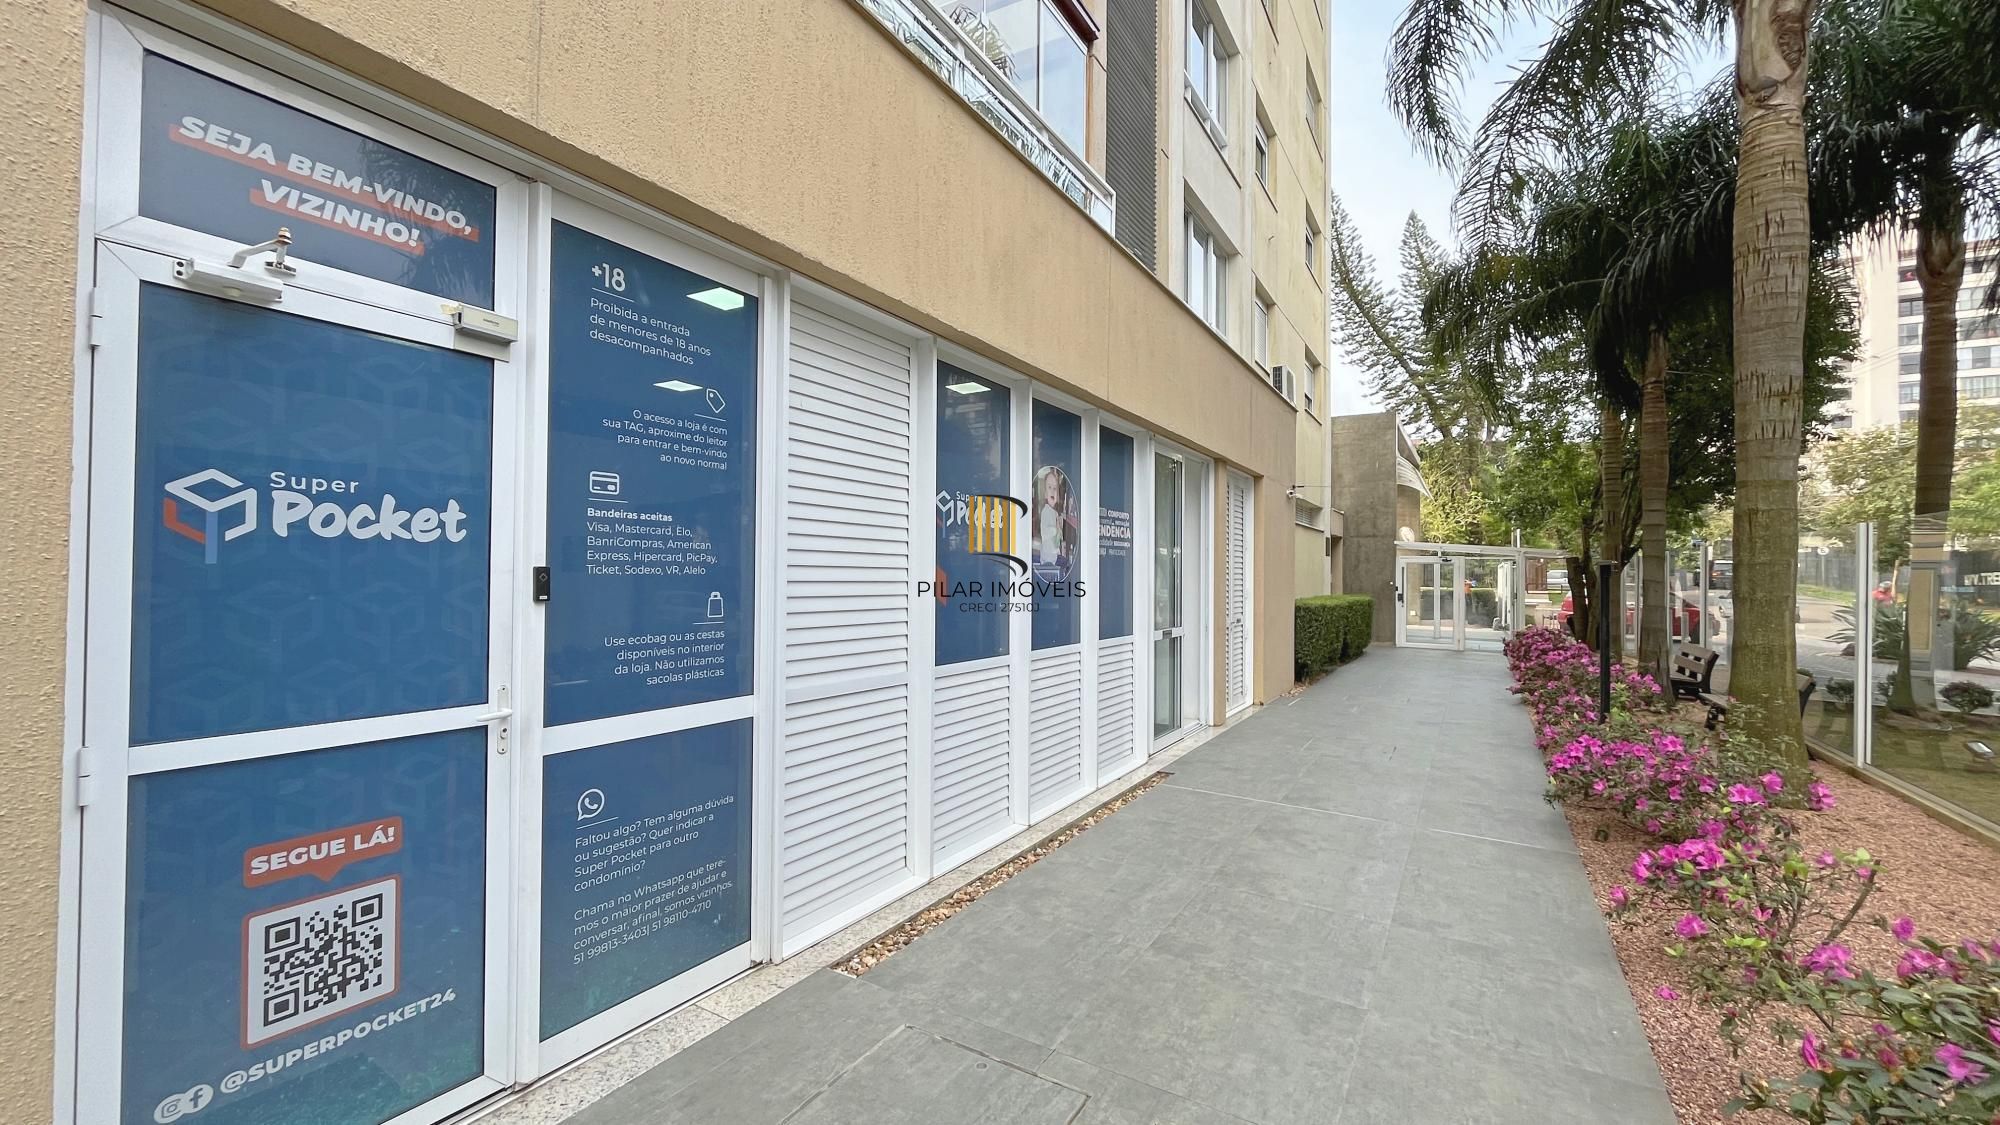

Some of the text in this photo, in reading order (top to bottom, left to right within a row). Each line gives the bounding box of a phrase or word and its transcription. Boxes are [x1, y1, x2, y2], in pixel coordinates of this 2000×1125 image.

[178, 116, 472, 234] SEJA BEM-VINDO,
[260, 180, 419, 246] VIZINHO!
[592, 263, 626, 291] +18
[591, 298, 690, 336] Proibida a entrada
[590, 314, 711, 356] de menores de 18 anos
[590, 329, 694, 365] desacompanhados
[603, 419, 727, 447] sua TAG, aproxime do leitor
[633, 410, 641, 419] O
[644, 413, 675, 425] acesso
[685, 420, 700, 431] loja
[702, 423, 707, 432] é
[709, 426, 727, 435] com
[618, 434, 639, 445] para
[643, 438, 671, 449] entrar
[681, 444, 727, 458] bem-vindo
[660, 454, 727, 470] ao novo normal
[270, 471, 359, 494] Super
[956, 490, 978, 502] Supr
[272, 491, 467, 542] Pocket
[587, 508, 672, 522] Bandeiras aceitas
[587, 522, 693, 537] Visa, Mastercard, Elo,
[587, 537, 711, 549] BanriCompras, American
[587, 551, 630, 562] Express,
[634, 553, 684, 564] Hipercard,
[586, 565, 622, 576] Ticket,
[625, 565, 663, 576] Sodexo,
[666, 566, 681, 575] VR,
[605, 636, 626, 646] Use
[628, 634, 666, 645] ecobag
[669, 633, 682, 641] ou
[697, 630, 725, 639] cestas
[617, 642, 724, 660] disponíveis no interior
[615, 665, 628, 675] da
[655, 660, 675, 670] Não
[678, 656, 724, 667] utilizamos
[647, 669, 724, 685] sacolas plásticas
[575, 795, 734, 848] Faltou algo? Tem alguma dúvida
[251, 824, 395, 875] SEGUE LÁ!
[575, 853, 590, 862] ou
[593, 833, 646, 856] sugestão?
[649, 827, 673, 840] Quer
[675, 818, 707, 831] indicar
[575, 831, 699, 878] Super Pocket para outro
[574, 860, 726, 921] Chama no Whatsapp que tere-
[575, 860, 645, 892] condomínio?
[575, 921, 599, 936] mos
[612, 906, 642, 920] maior
[645, 891, 675, 909] prazer
[678, 885, 689, 894] de
[692, 875, 718, 890] ajudar
[573, 953, 584, 965] 51
[652, 921, 661, 931] 51
[664, 900, 711, 927] 98110-4710
[574, 924, 630, 950] conversar,
[633, 907, 663, 926] afinal,
[664, 896, 695, 912] somos
[221, 988, 456, 1093] @SUPERPOCKET24
